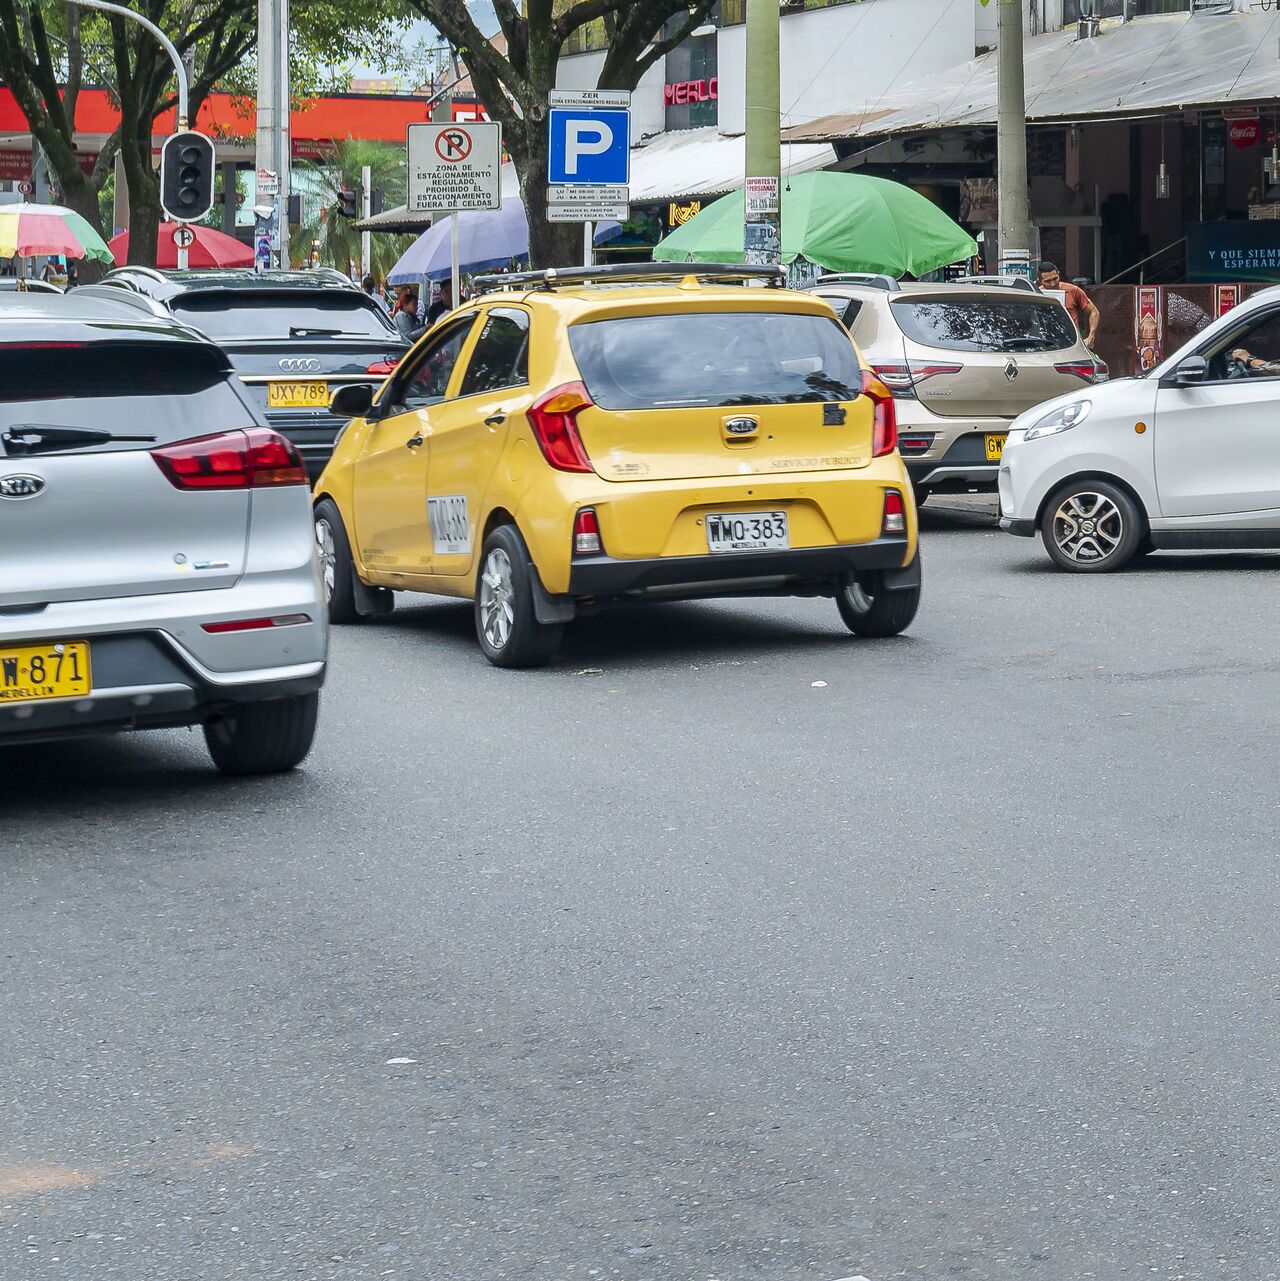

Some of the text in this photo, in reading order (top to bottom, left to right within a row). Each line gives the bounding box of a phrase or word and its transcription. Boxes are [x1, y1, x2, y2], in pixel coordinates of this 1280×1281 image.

[565, 119, 614, 175] P
[417, 171, 491, 180] ESTACIONAMIENTO
[417, 193, 491, 201] ESTACIONAMIENTO
[1208, 250, 1216, 260] Y
[1220, 250, 1243, 259] QUE
